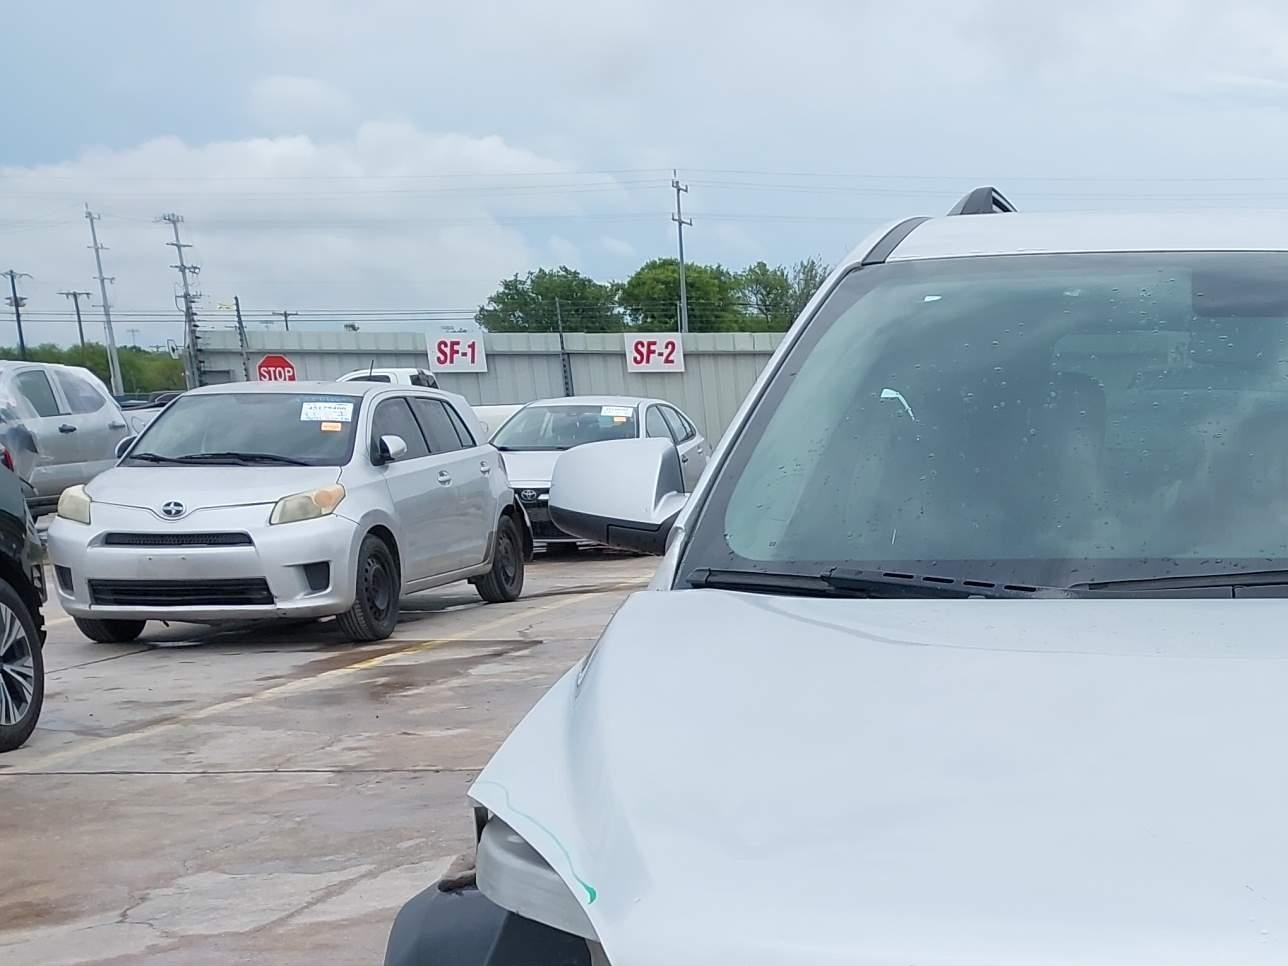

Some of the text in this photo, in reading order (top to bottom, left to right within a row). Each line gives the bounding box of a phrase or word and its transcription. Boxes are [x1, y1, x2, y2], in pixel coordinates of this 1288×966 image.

[436, 340, 476, 365] SF-1
[632, 340, 676, 365] SF-2
[260, 367, 294, 381] STOP
